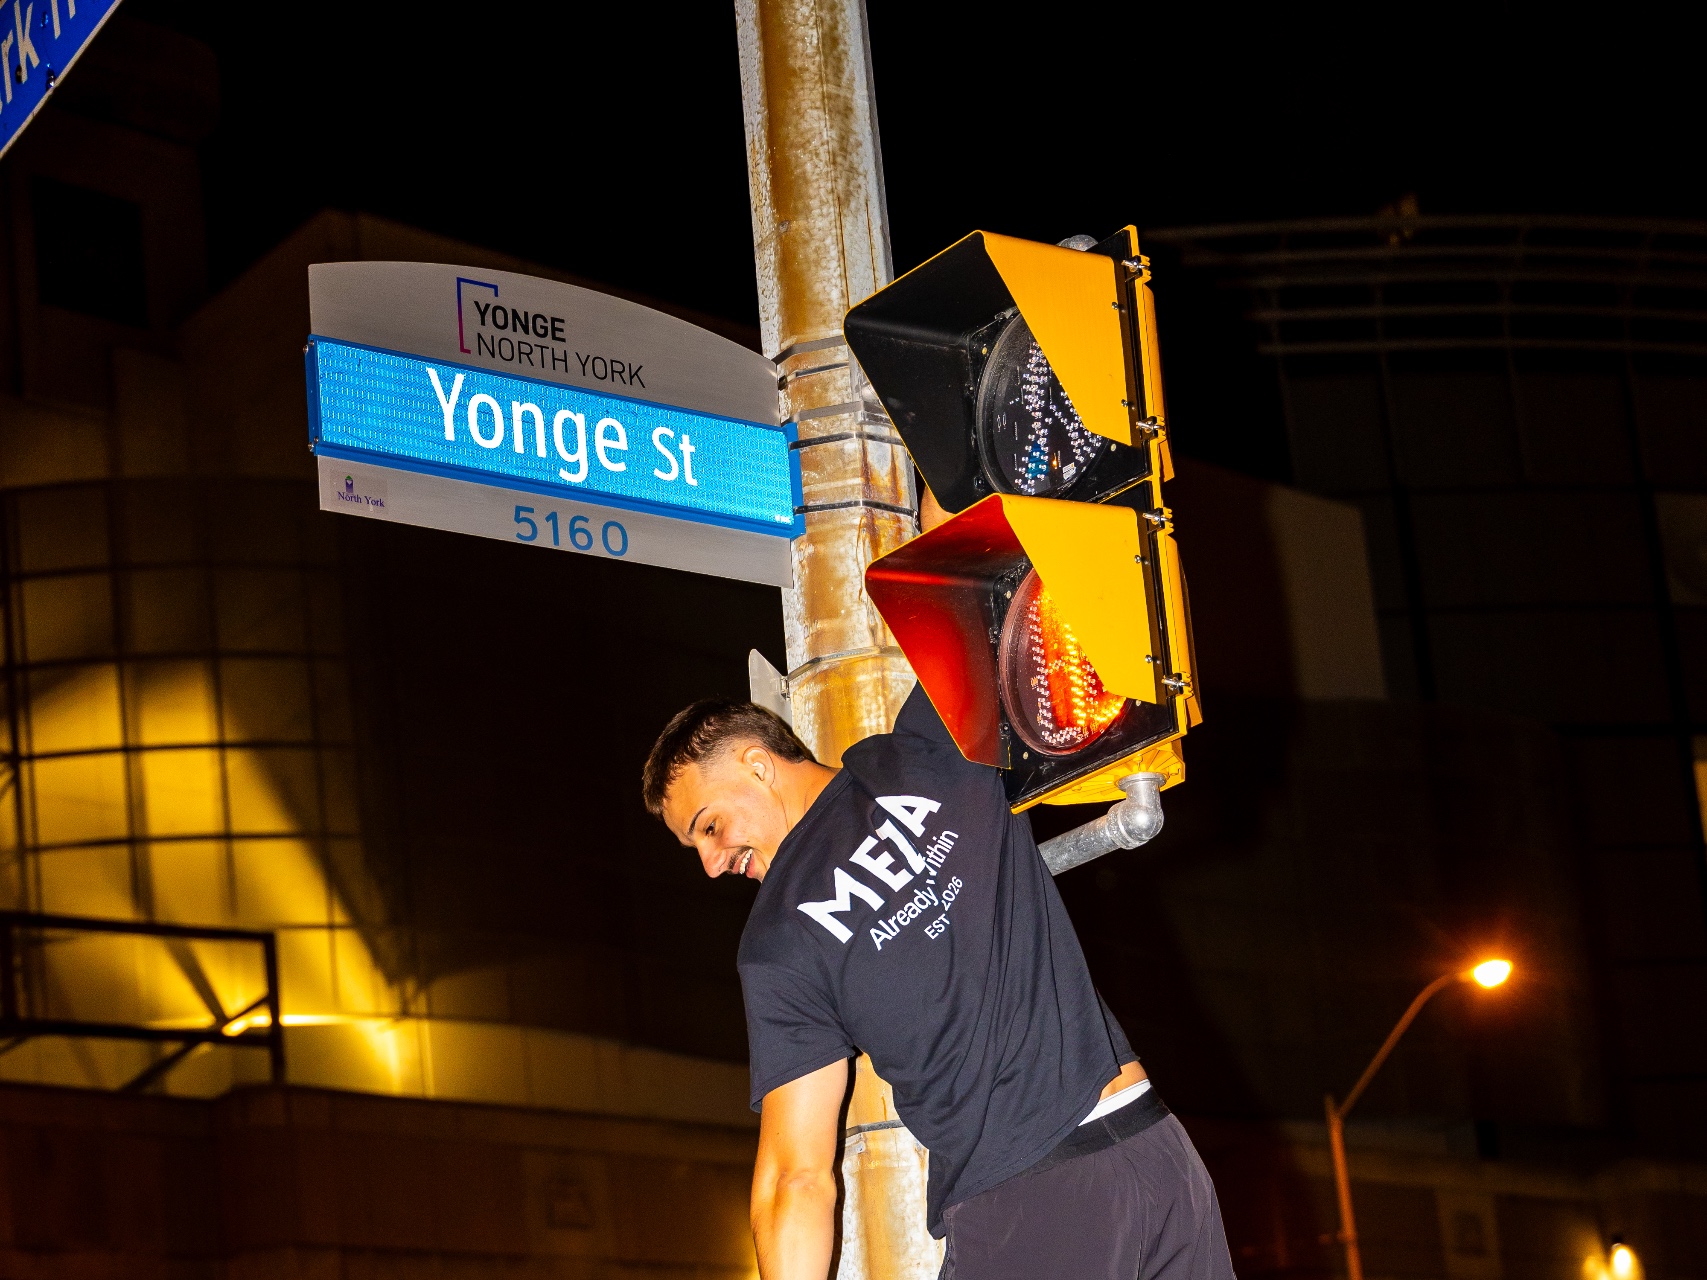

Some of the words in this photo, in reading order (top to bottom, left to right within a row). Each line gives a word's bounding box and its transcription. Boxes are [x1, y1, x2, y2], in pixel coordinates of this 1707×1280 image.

[474, 301, 566, 343] YONGE
[477, 333, 569, 374] NORTH
[575, 352, 646, 389] YORK
[425, 367, 629, 483] Yonge
[652, 426, 698, 486] St
[337, 491, 362, 504] North
[364, 495, 385, 508] York
[513, 505, 629, 556] 5160
[869, 887, 939, 951] Already
[924, 913, 951, 940] EST
